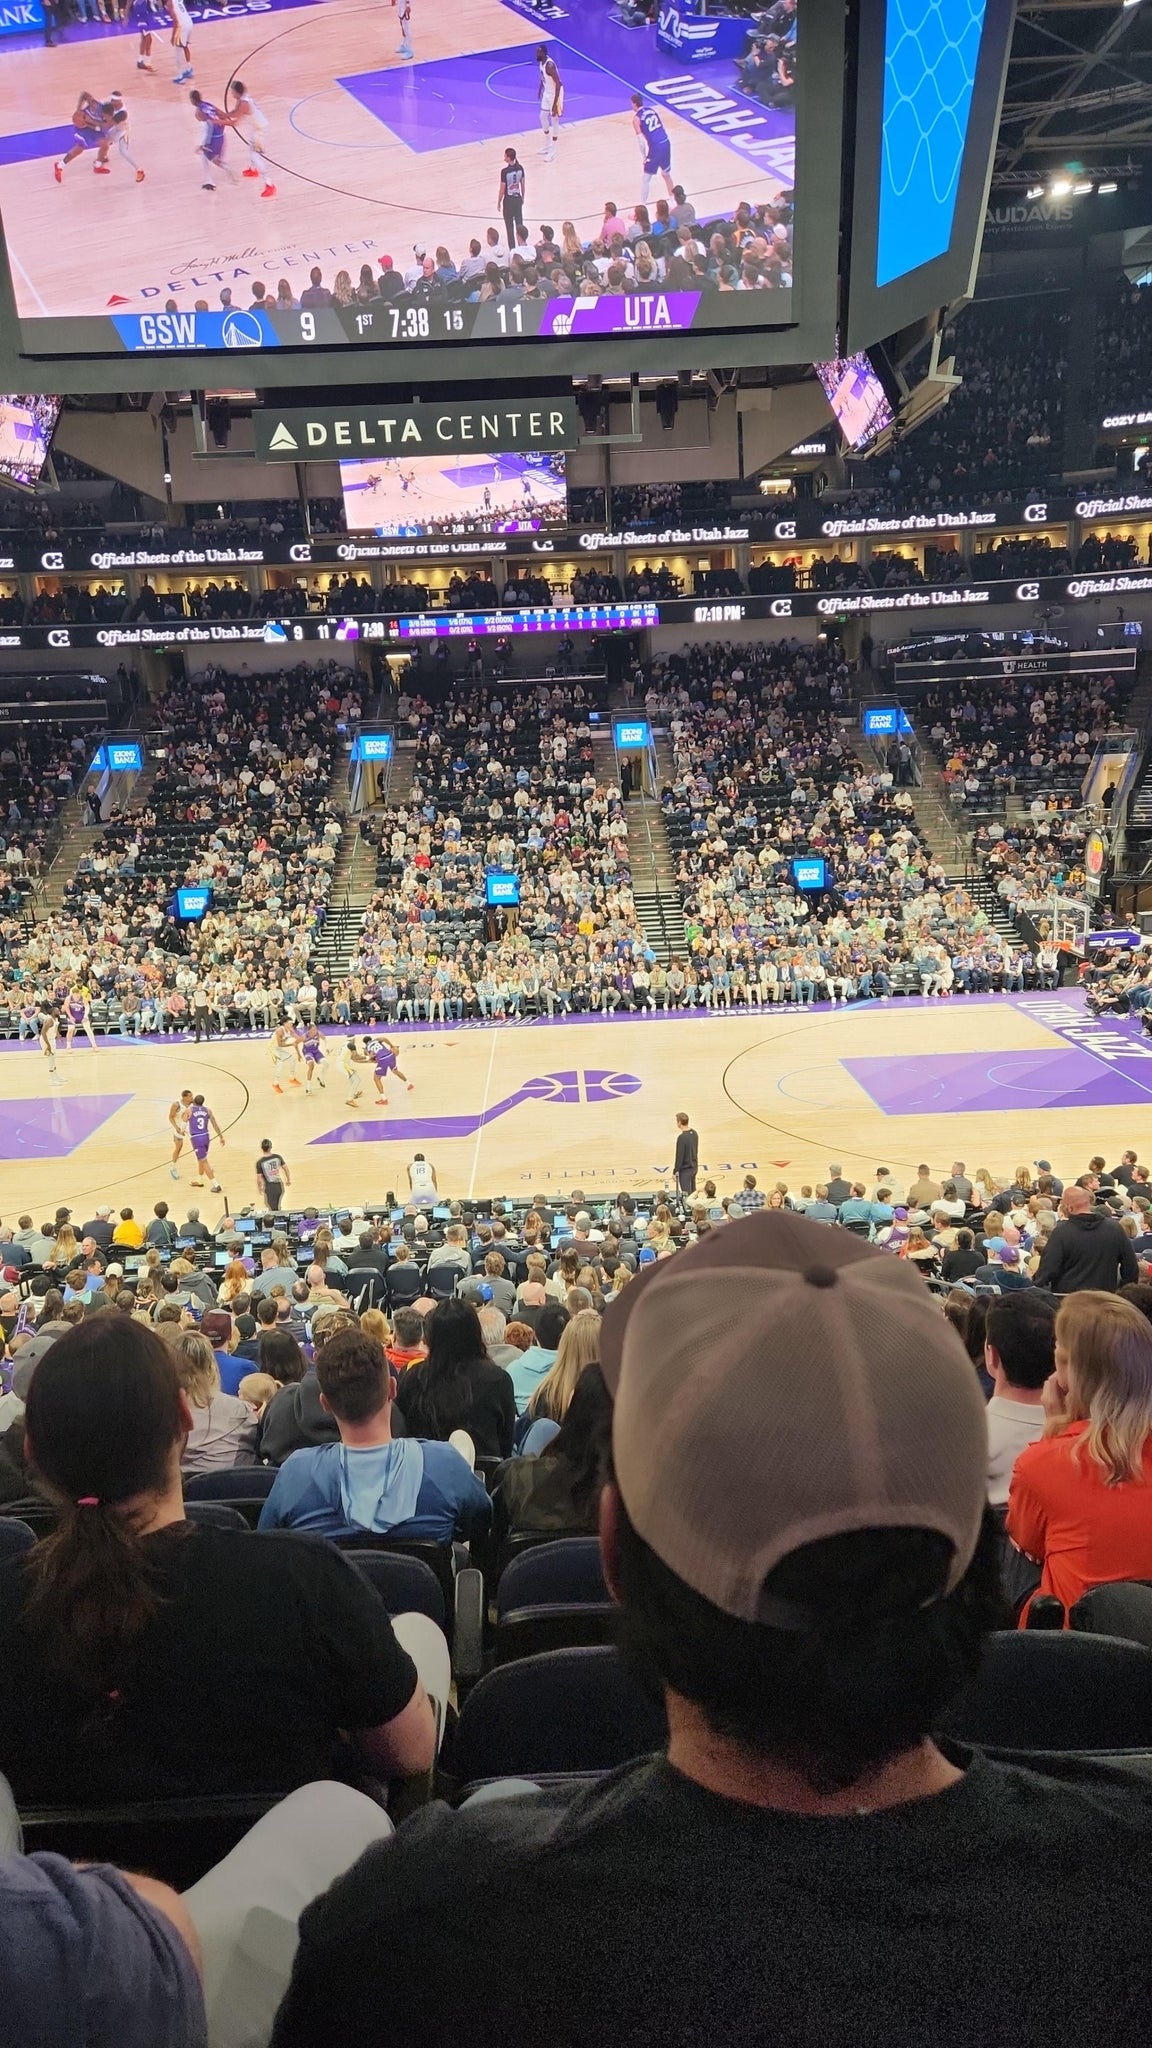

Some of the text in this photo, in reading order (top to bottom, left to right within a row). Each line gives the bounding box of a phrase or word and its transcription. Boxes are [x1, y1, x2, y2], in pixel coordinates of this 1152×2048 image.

[645, 75, 768, 133] UTAH
[645, 115, 662, 132] 22
[141, 239, 380, 298] DELTA CENTER
[496, 304, 523, 333] 11
[625, 295, 671, 327] UTA
[139, 314, 196, 345] GSW
[300, 312, 316, 341] 9
[355, 308, 463, 338] 1ST 7:38 15
[307, 411, 565, 446] DELTA CENTER
[1103, 414, 1136, 428] COZY
[1076, 495, 1152, 518] Official Shee
[823, 512, 996, 537] Official Sheets of the Utah Jazz
[580, 528, 749, 549] Official Sheets of the Utah Jazz
[91, 548, 263, 569] Official Sheets of the Utah Jazz
[1068, 578, 1115, 597] Official
[817, 590, 989, 614] Official Sheets of the Utah Jazz
[97, 630, 140, 646] Official
[141, 629, 174, 642] Sheets
[176, 628, 189, 641] of
[189, 627, 210, 640] the
[210, 626, 240, 639] Utah
[293, 625, 303, 640] 9
[317, 625, 329, 639] 11
[362, 622, 384, 637] 7:38
[0, 636, 20, 646] azz
[1017, 661, 1047, 669] HEALTH
[1017, 1000, 1102, 1027] UTAH
[197, 1118, 204, 1129] 3
[417, 1167, 425, 1175] 18
[520, 1162, 759, 1180] DELA CENTER
